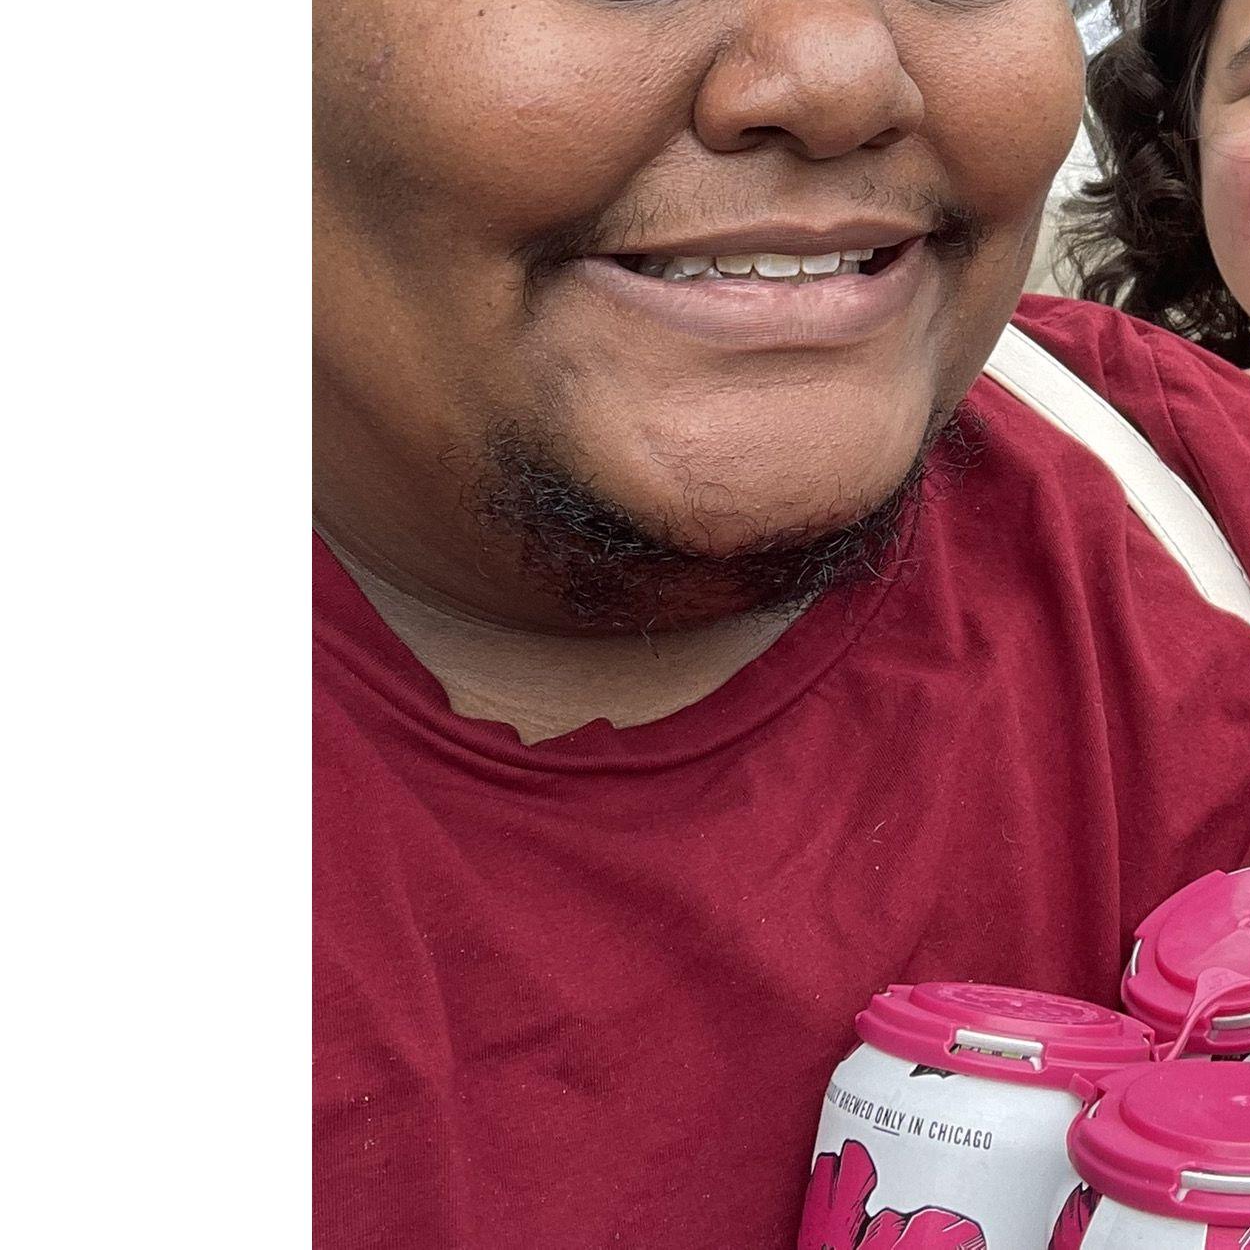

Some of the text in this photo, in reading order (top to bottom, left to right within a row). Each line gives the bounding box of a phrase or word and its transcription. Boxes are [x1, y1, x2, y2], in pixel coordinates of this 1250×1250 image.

[839, 1091, 873, 1120] BREWED
[875, 1106, 905, 1132] ONLY
[908, 1116, 924, 1136] IN
[928, 1121, 993, 1150] CHICAGO
